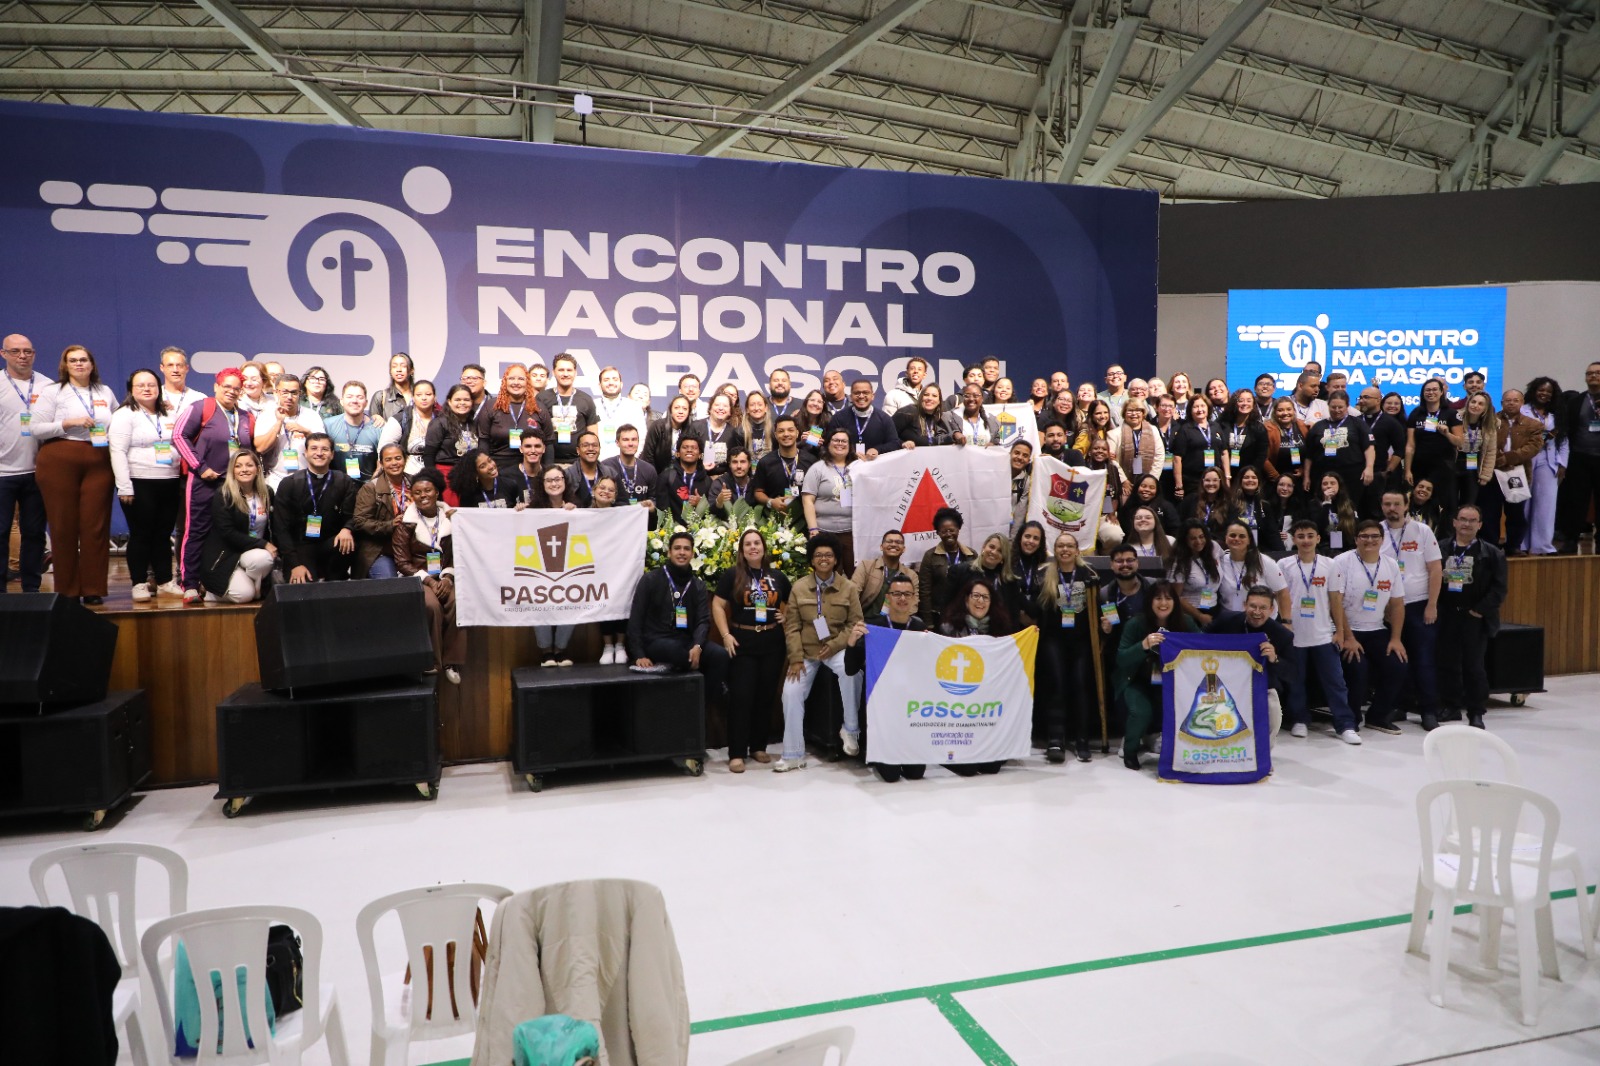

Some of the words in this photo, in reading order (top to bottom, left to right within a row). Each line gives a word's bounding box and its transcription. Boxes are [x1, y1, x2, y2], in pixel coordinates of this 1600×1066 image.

[477, 226, 976, 297] ENCONTRO
[478, 286, 934, 348] NACIONAL
[1332, 329, 1479, 347] ENCONTRO
[1331, 349, 1464, 366] NACIONAL
[932, 467, 949, 491] QUE
[894, 469, 920, 523] LIBERTAS
[500, 582, 609, 605] PASCOM
